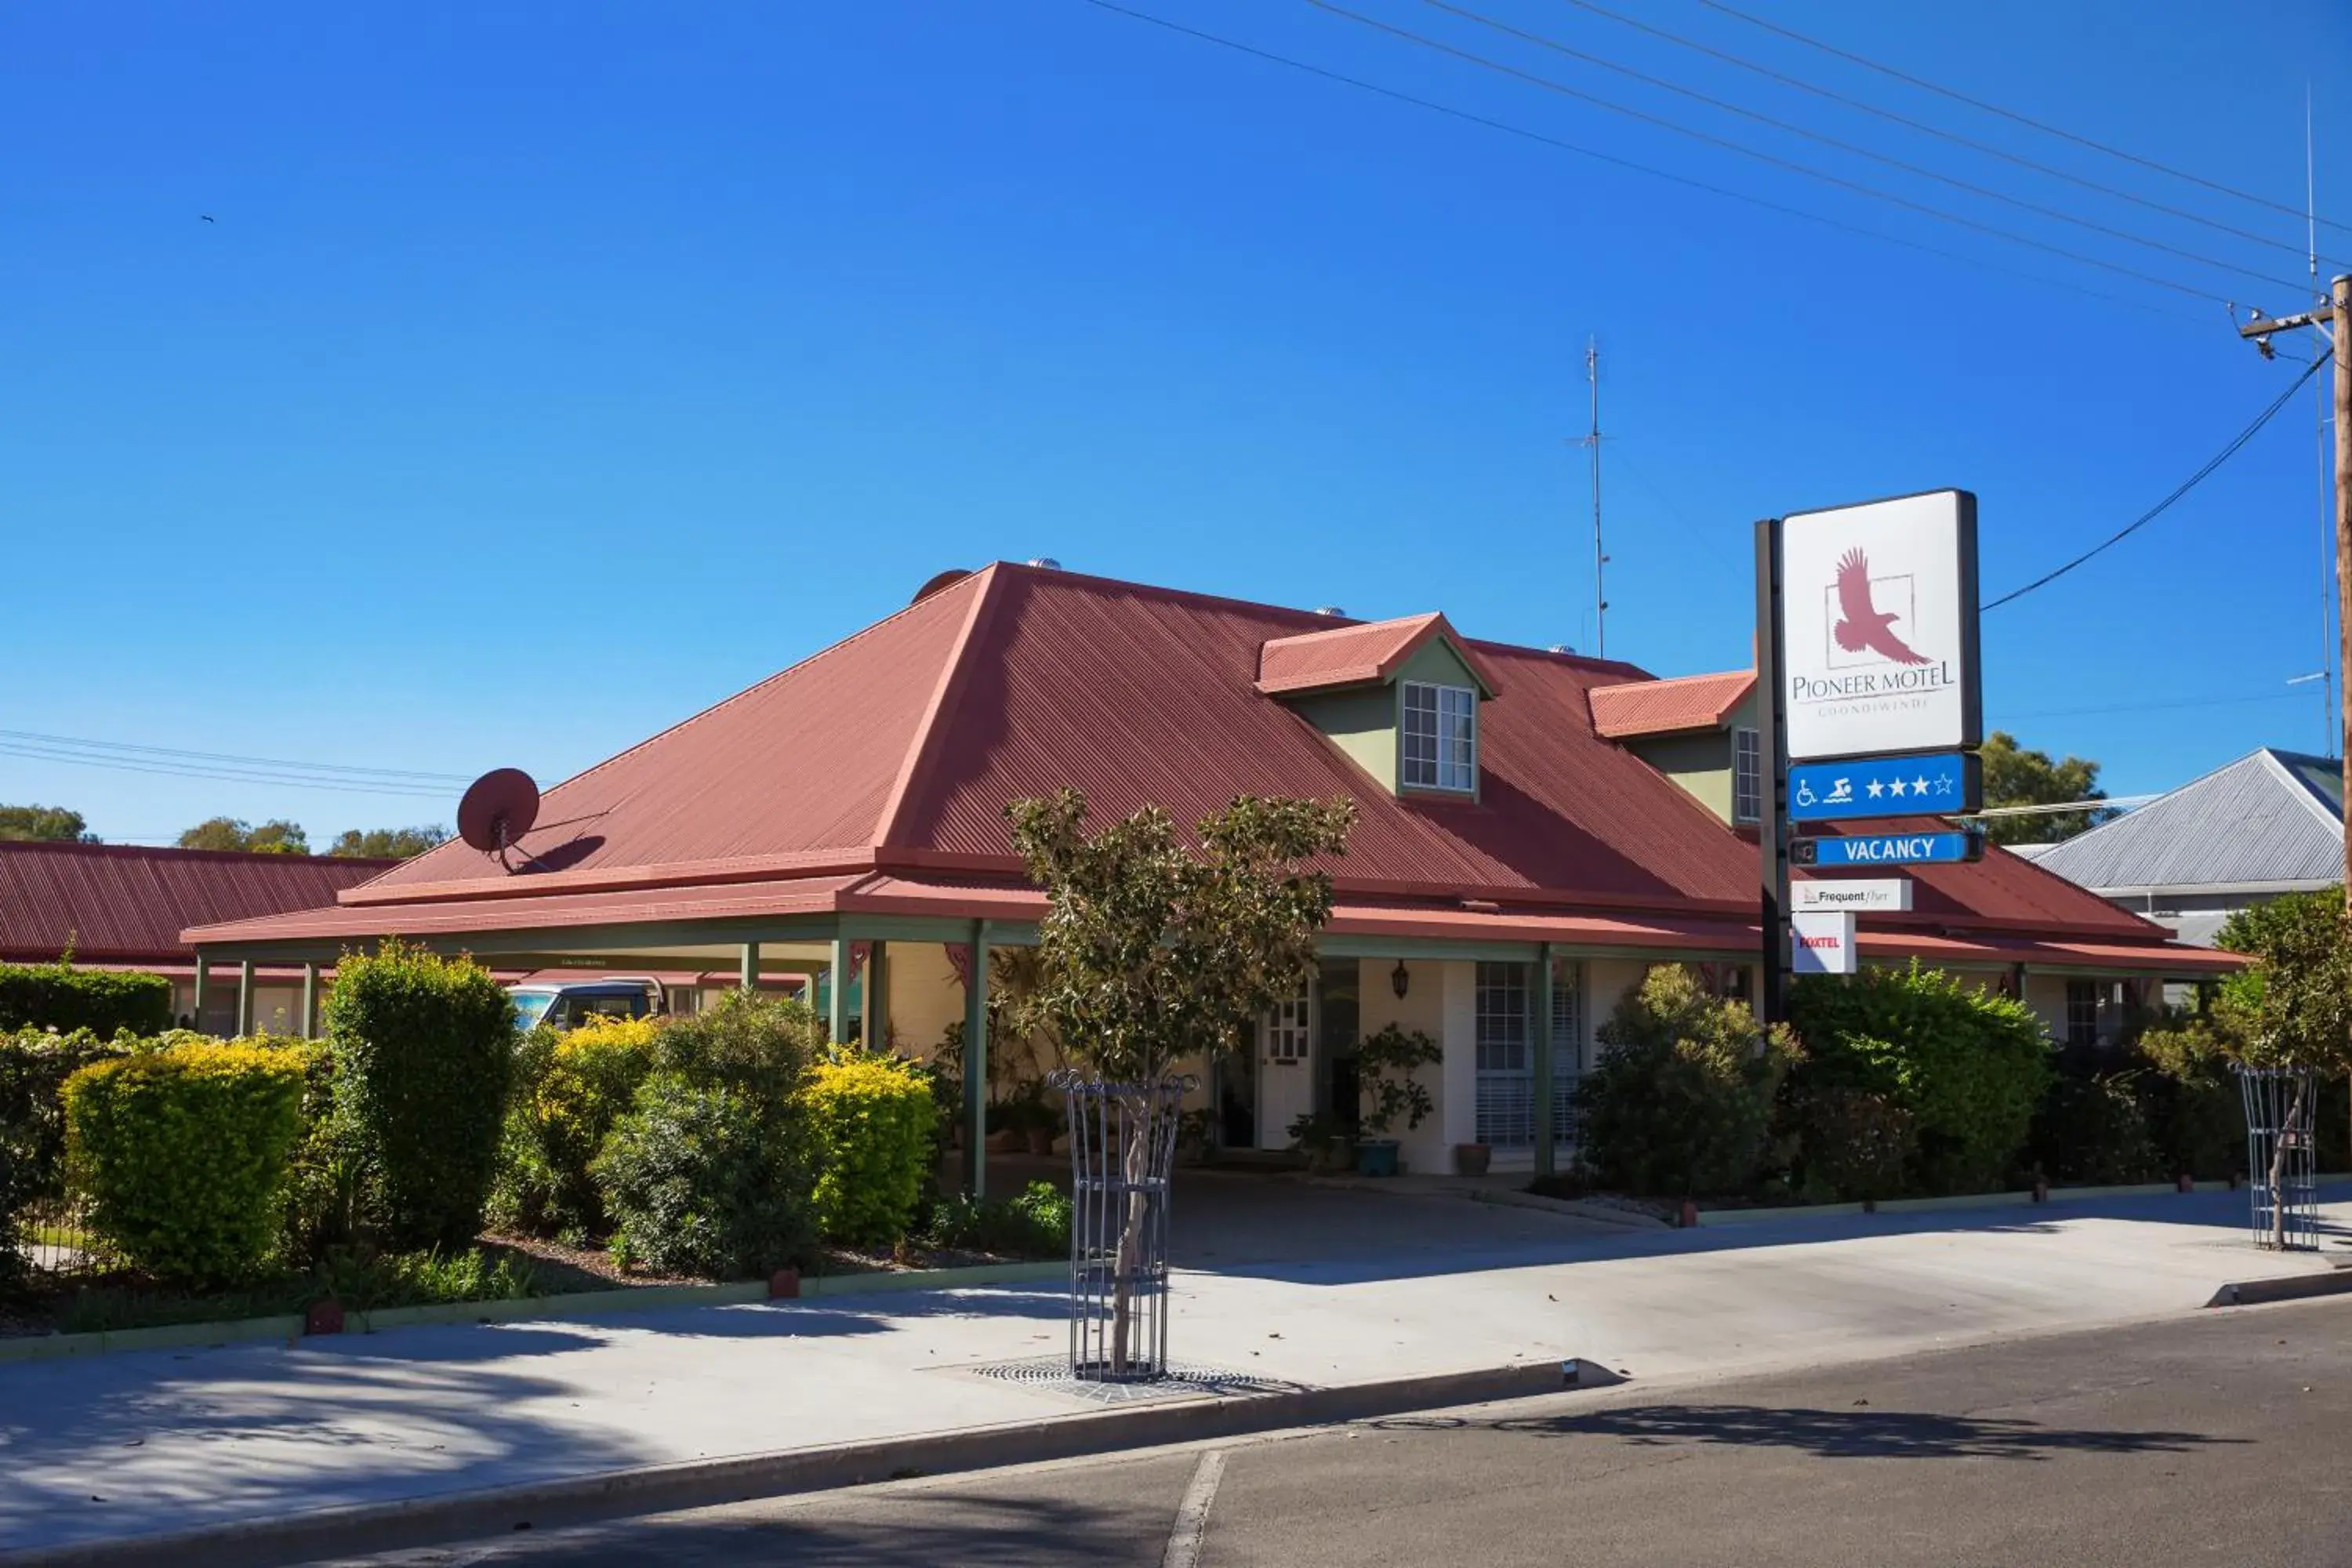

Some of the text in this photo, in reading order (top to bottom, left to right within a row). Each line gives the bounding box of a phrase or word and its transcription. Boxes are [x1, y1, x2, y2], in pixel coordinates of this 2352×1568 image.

[1793, 661, 1955, 699] PIONEER MOTEL
[1845, 838, 1935, 860] VACANCY
[1819, 891, 1864, 903] Frequent
[1800, 937, 1840, 949] FOXTEL
